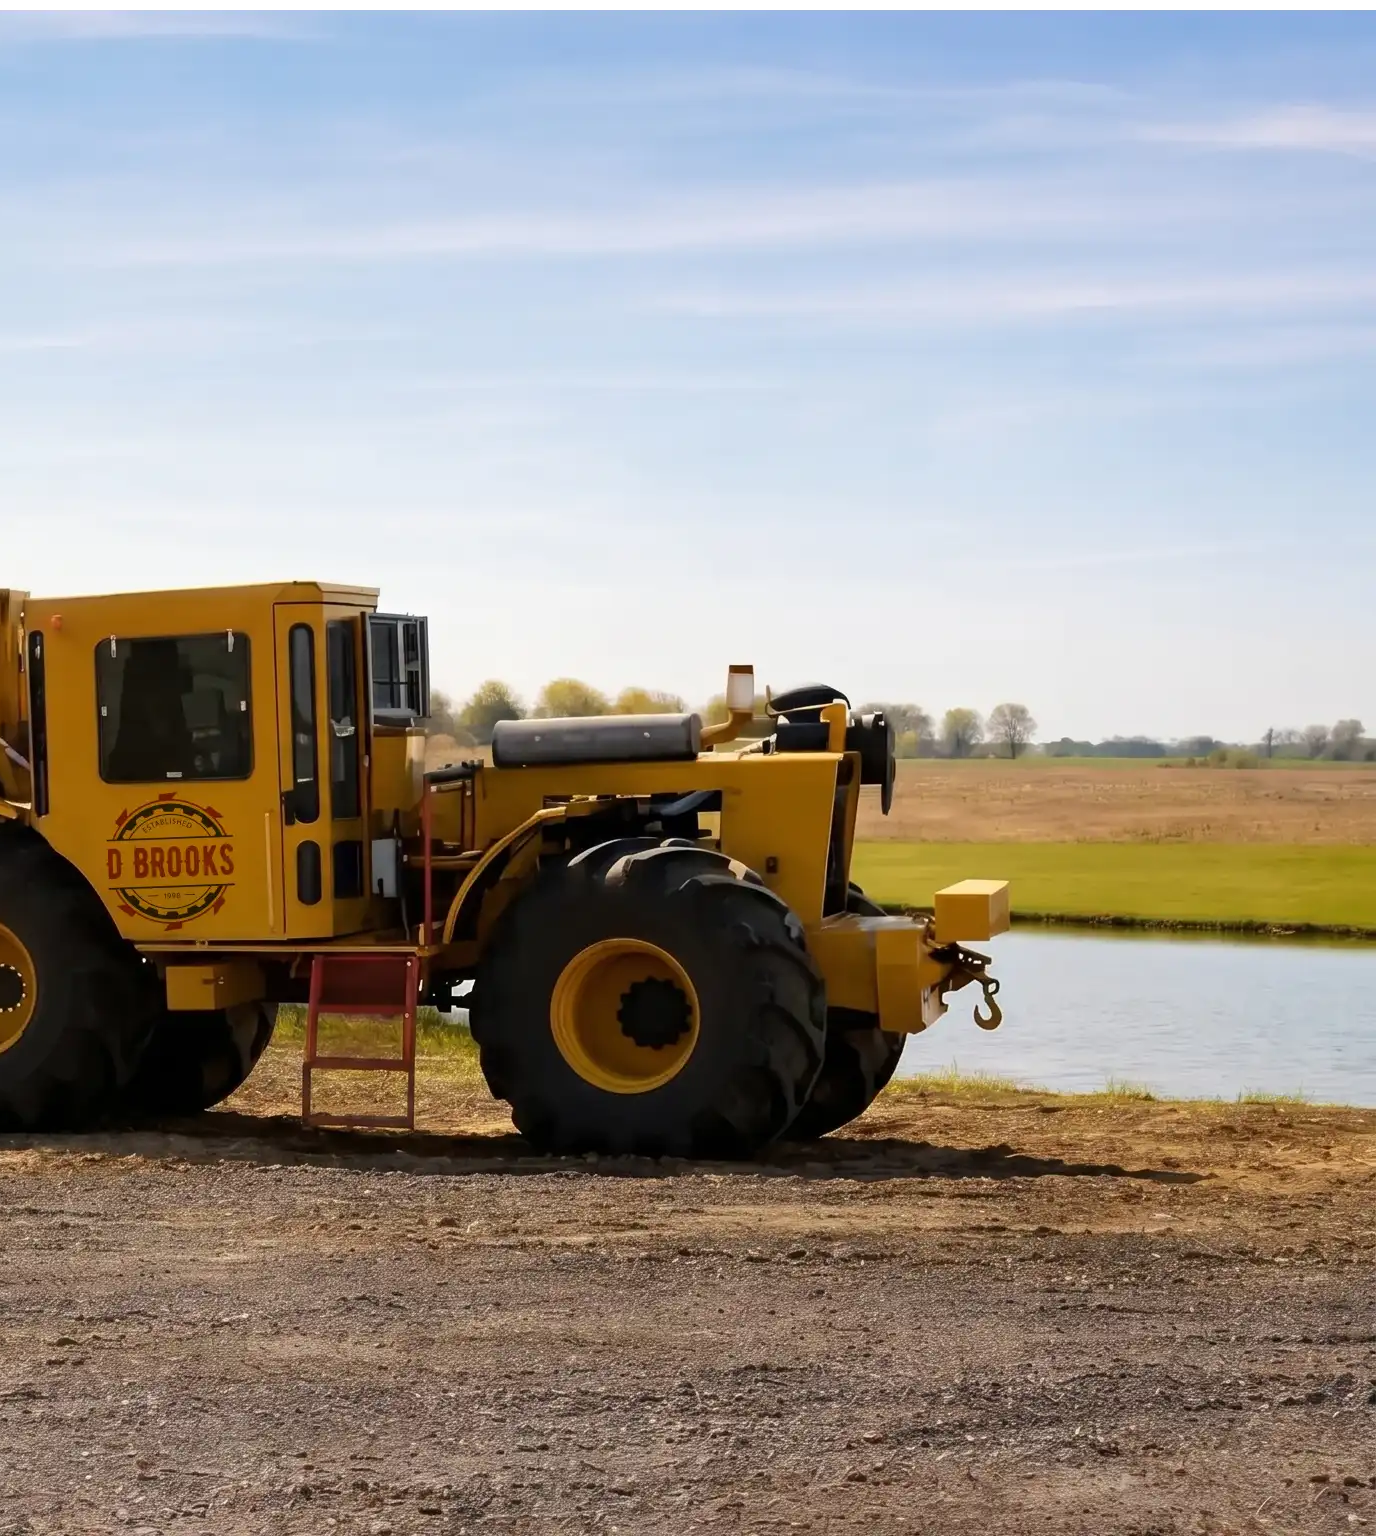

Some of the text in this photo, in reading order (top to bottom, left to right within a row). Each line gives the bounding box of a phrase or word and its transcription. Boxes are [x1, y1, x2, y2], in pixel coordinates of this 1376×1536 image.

[141, 818, 193, 834] ESTABLISHED
[106, 843, 235, 880] D BROOKS
